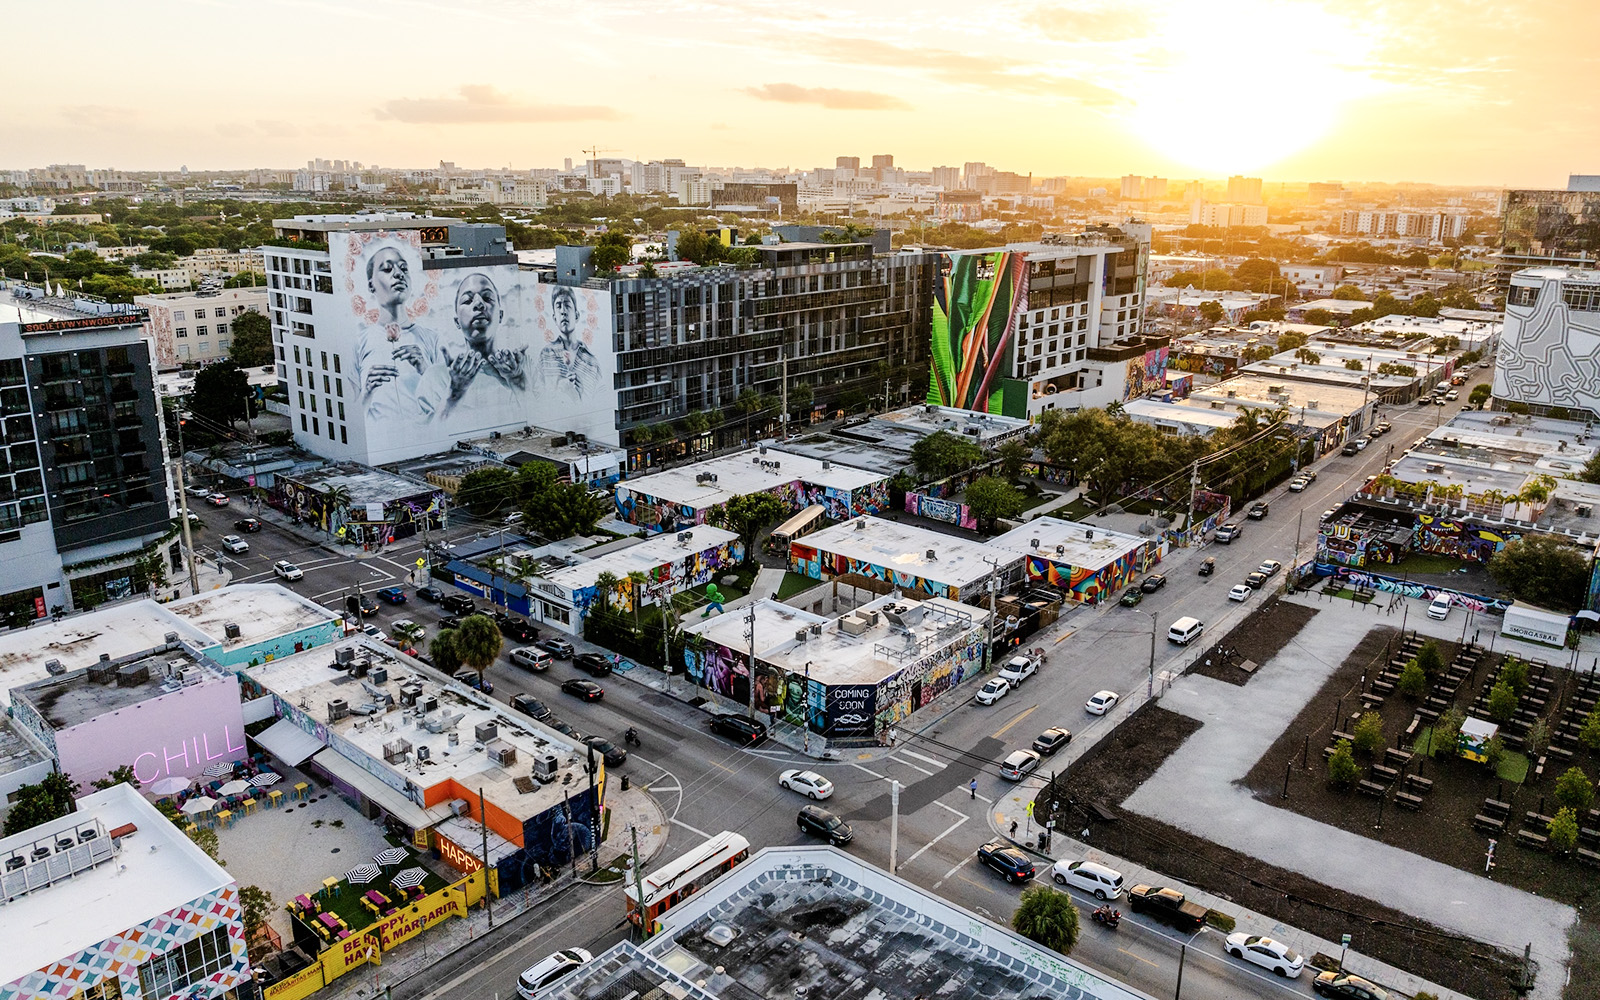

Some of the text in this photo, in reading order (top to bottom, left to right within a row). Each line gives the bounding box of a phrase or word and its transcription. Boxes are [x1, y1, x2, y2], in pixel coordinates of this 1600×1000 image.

[26, 315, 137, 332] SOCIETYWYNWOOD.COM
[1509, 626, 1557, 642] SMORGASBAR
[835, 689, 870, 699] COMING
[839, 700, 865, 710] SOON
[133, 725, 245, 784] CHILL
[382, 936, 391, 947] A
[393, 901, 459, 941] MARGARITA
[343, 937, 362, 954] BE
